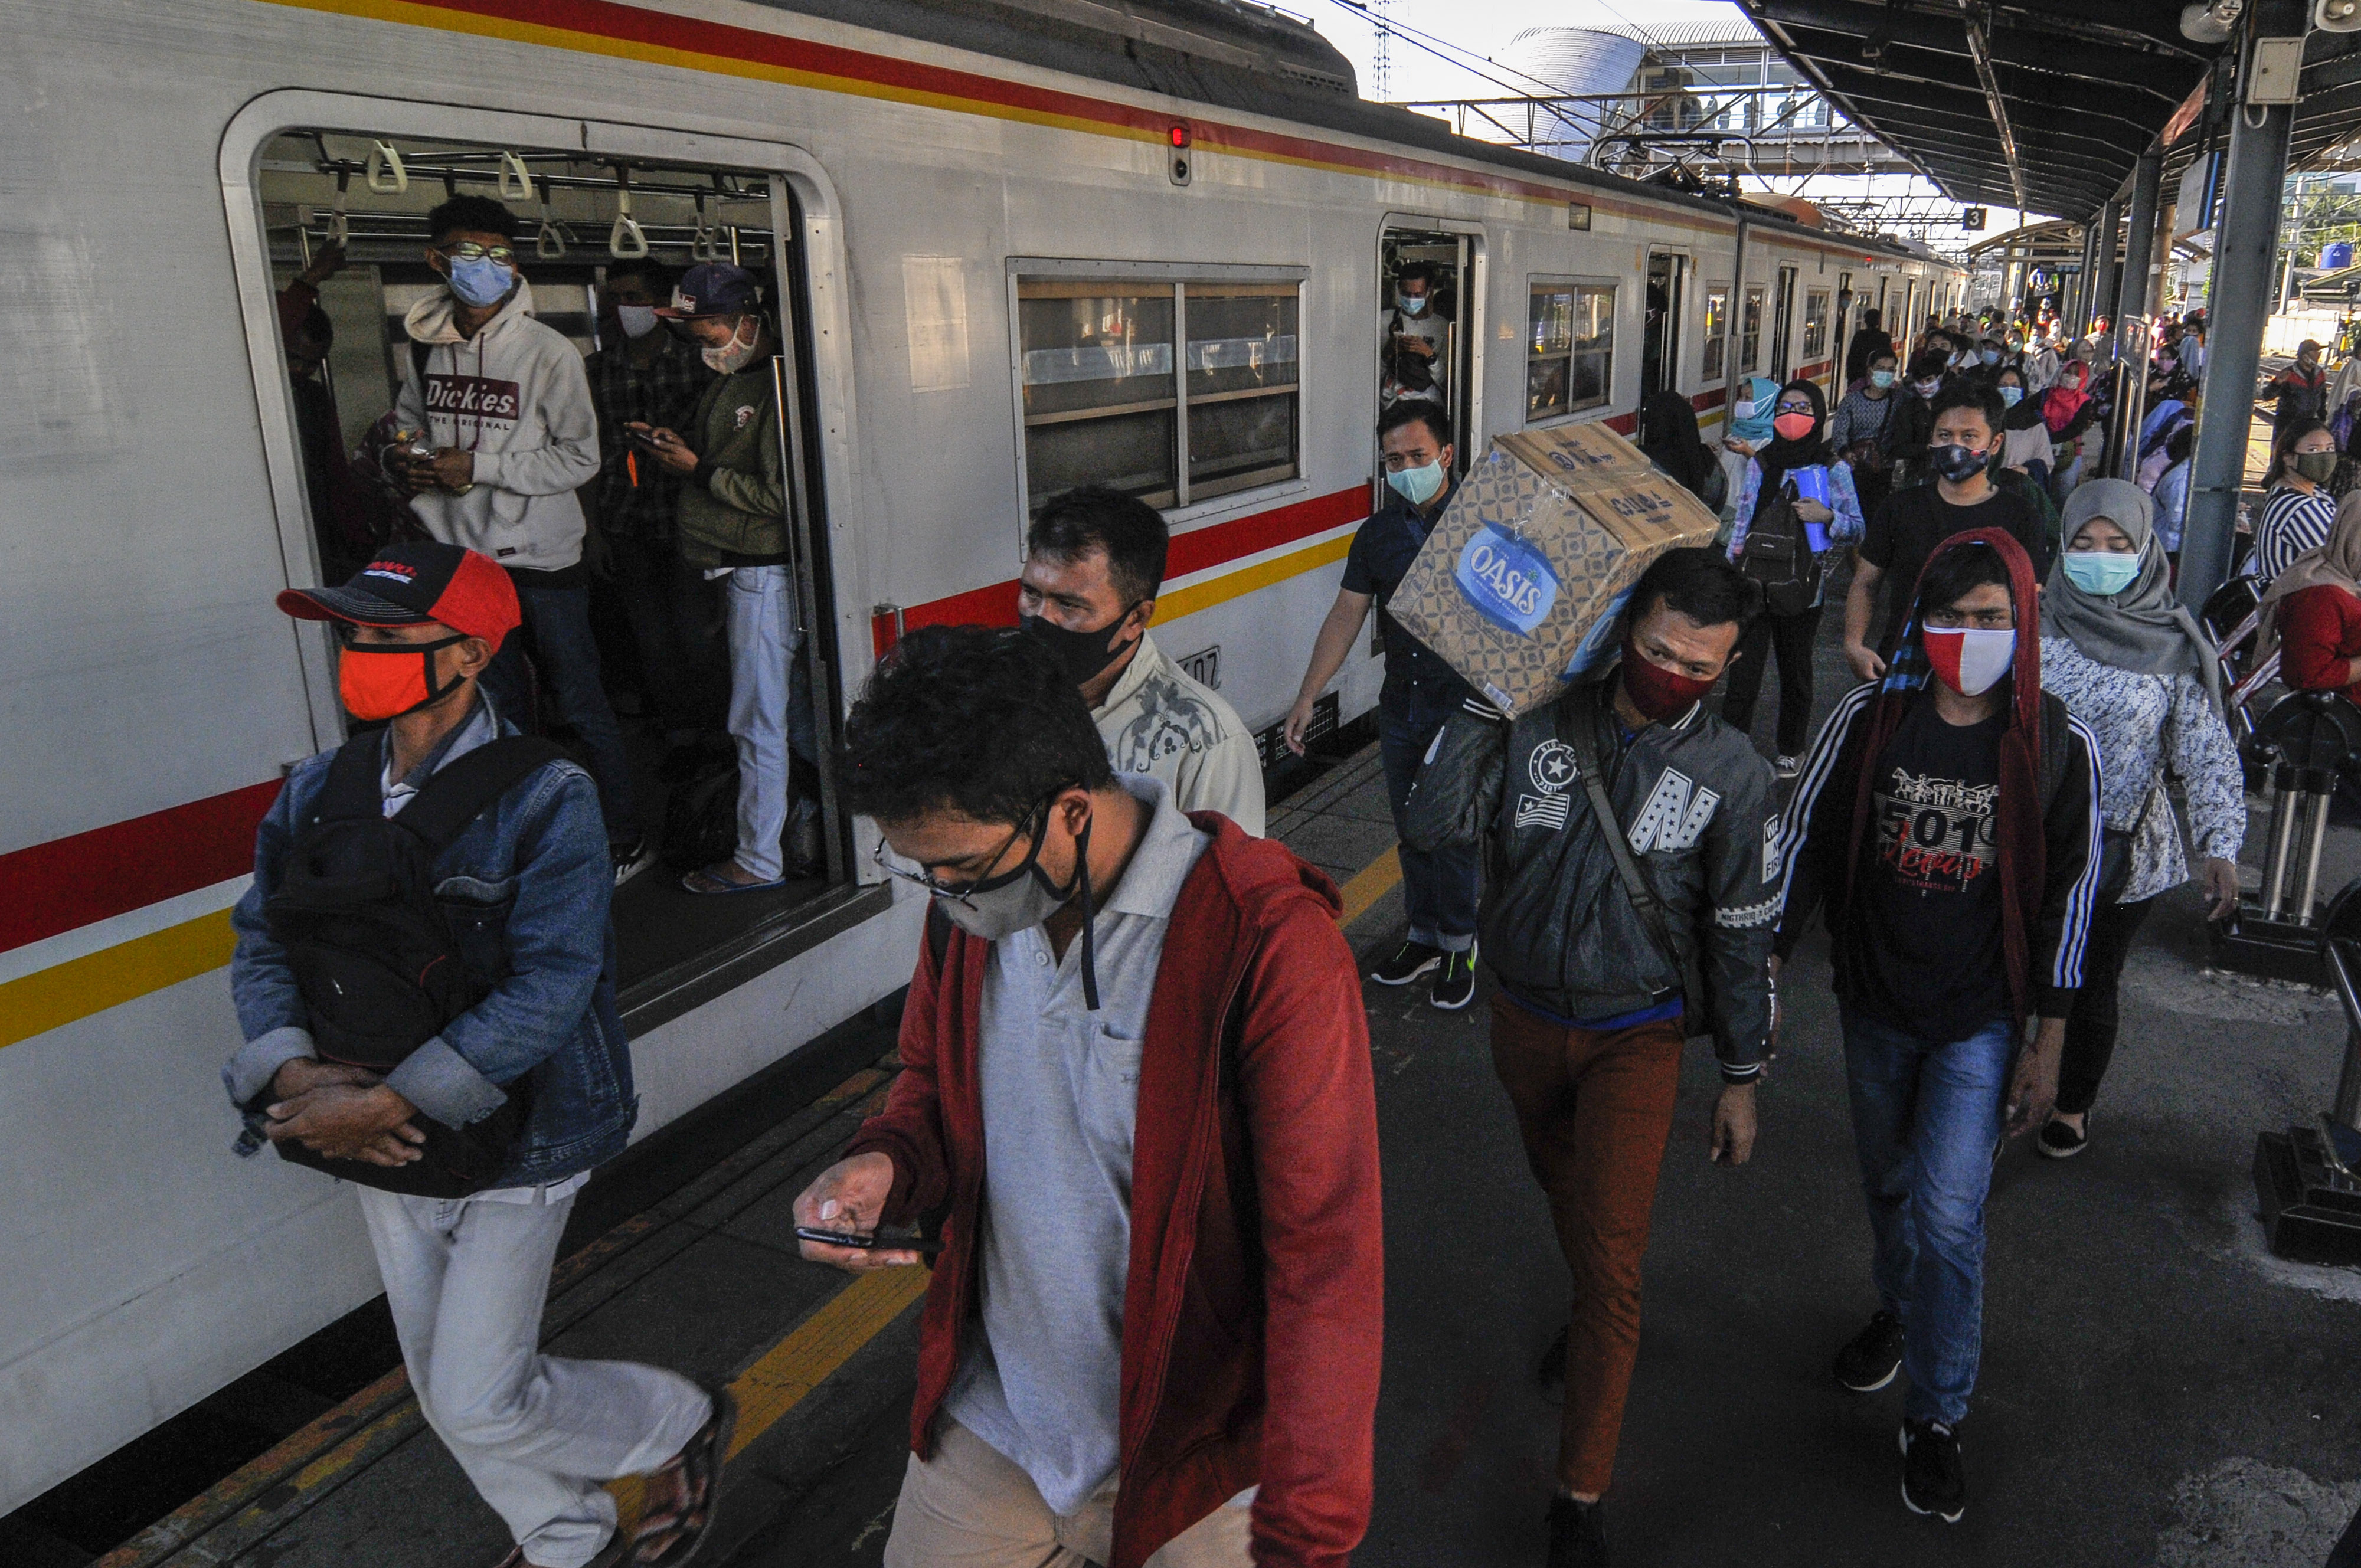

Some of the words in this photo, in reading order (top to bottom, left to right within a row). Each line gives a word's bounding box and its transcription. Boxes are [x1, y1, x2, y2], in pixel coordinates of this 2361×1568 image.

[1969, 211, 1980, 227] 3
[426, 379, 515, 414] Dickies
[430, 416, 447, 424] THE
[1471, 545, 1542, 615] OASIS
[1627, 766, 1720, 856] N
